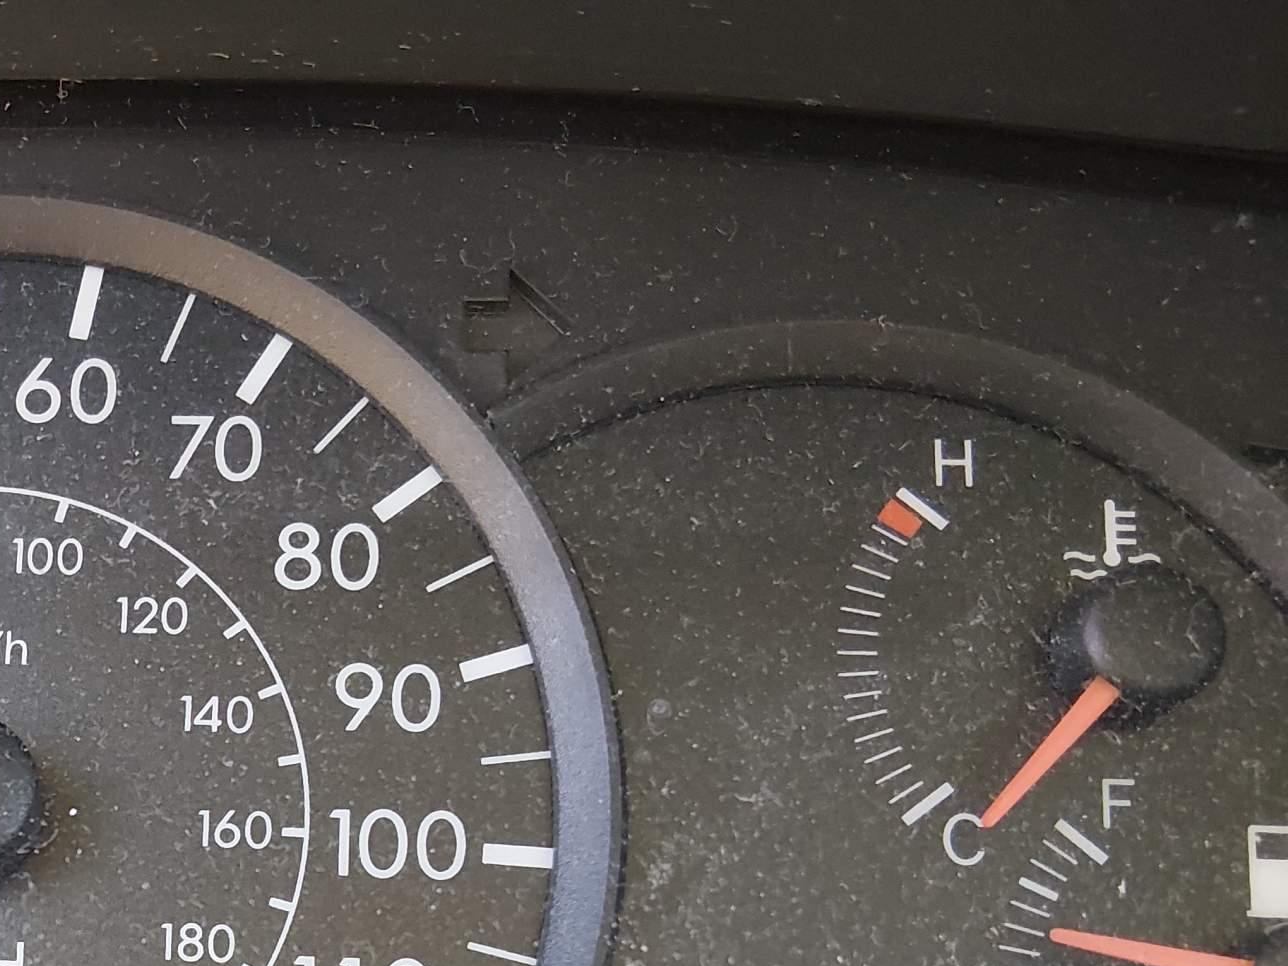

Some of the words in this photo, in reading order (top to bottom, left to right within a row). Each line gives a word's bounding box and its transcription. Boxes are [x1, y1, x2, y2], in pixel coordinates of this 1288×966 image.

[15, 357, 116, 424] 60
[169, 415, 262, 482] 70
[934, 439, 973, 486] H
[13, 538, 83, 575] 100
[273, 523, 379, 590] 80
[116, 597, 188, 635] 120
[180, 696, 254, 733] 140
[335, 663, 441, 732] 90
[1102, 778, 1134, 828] F
[198, 810, 273, 849] 160
[329, 809, 466, 880] 100
[943, 812, 985, 866] C
[161, 923, 236, 963] 180
